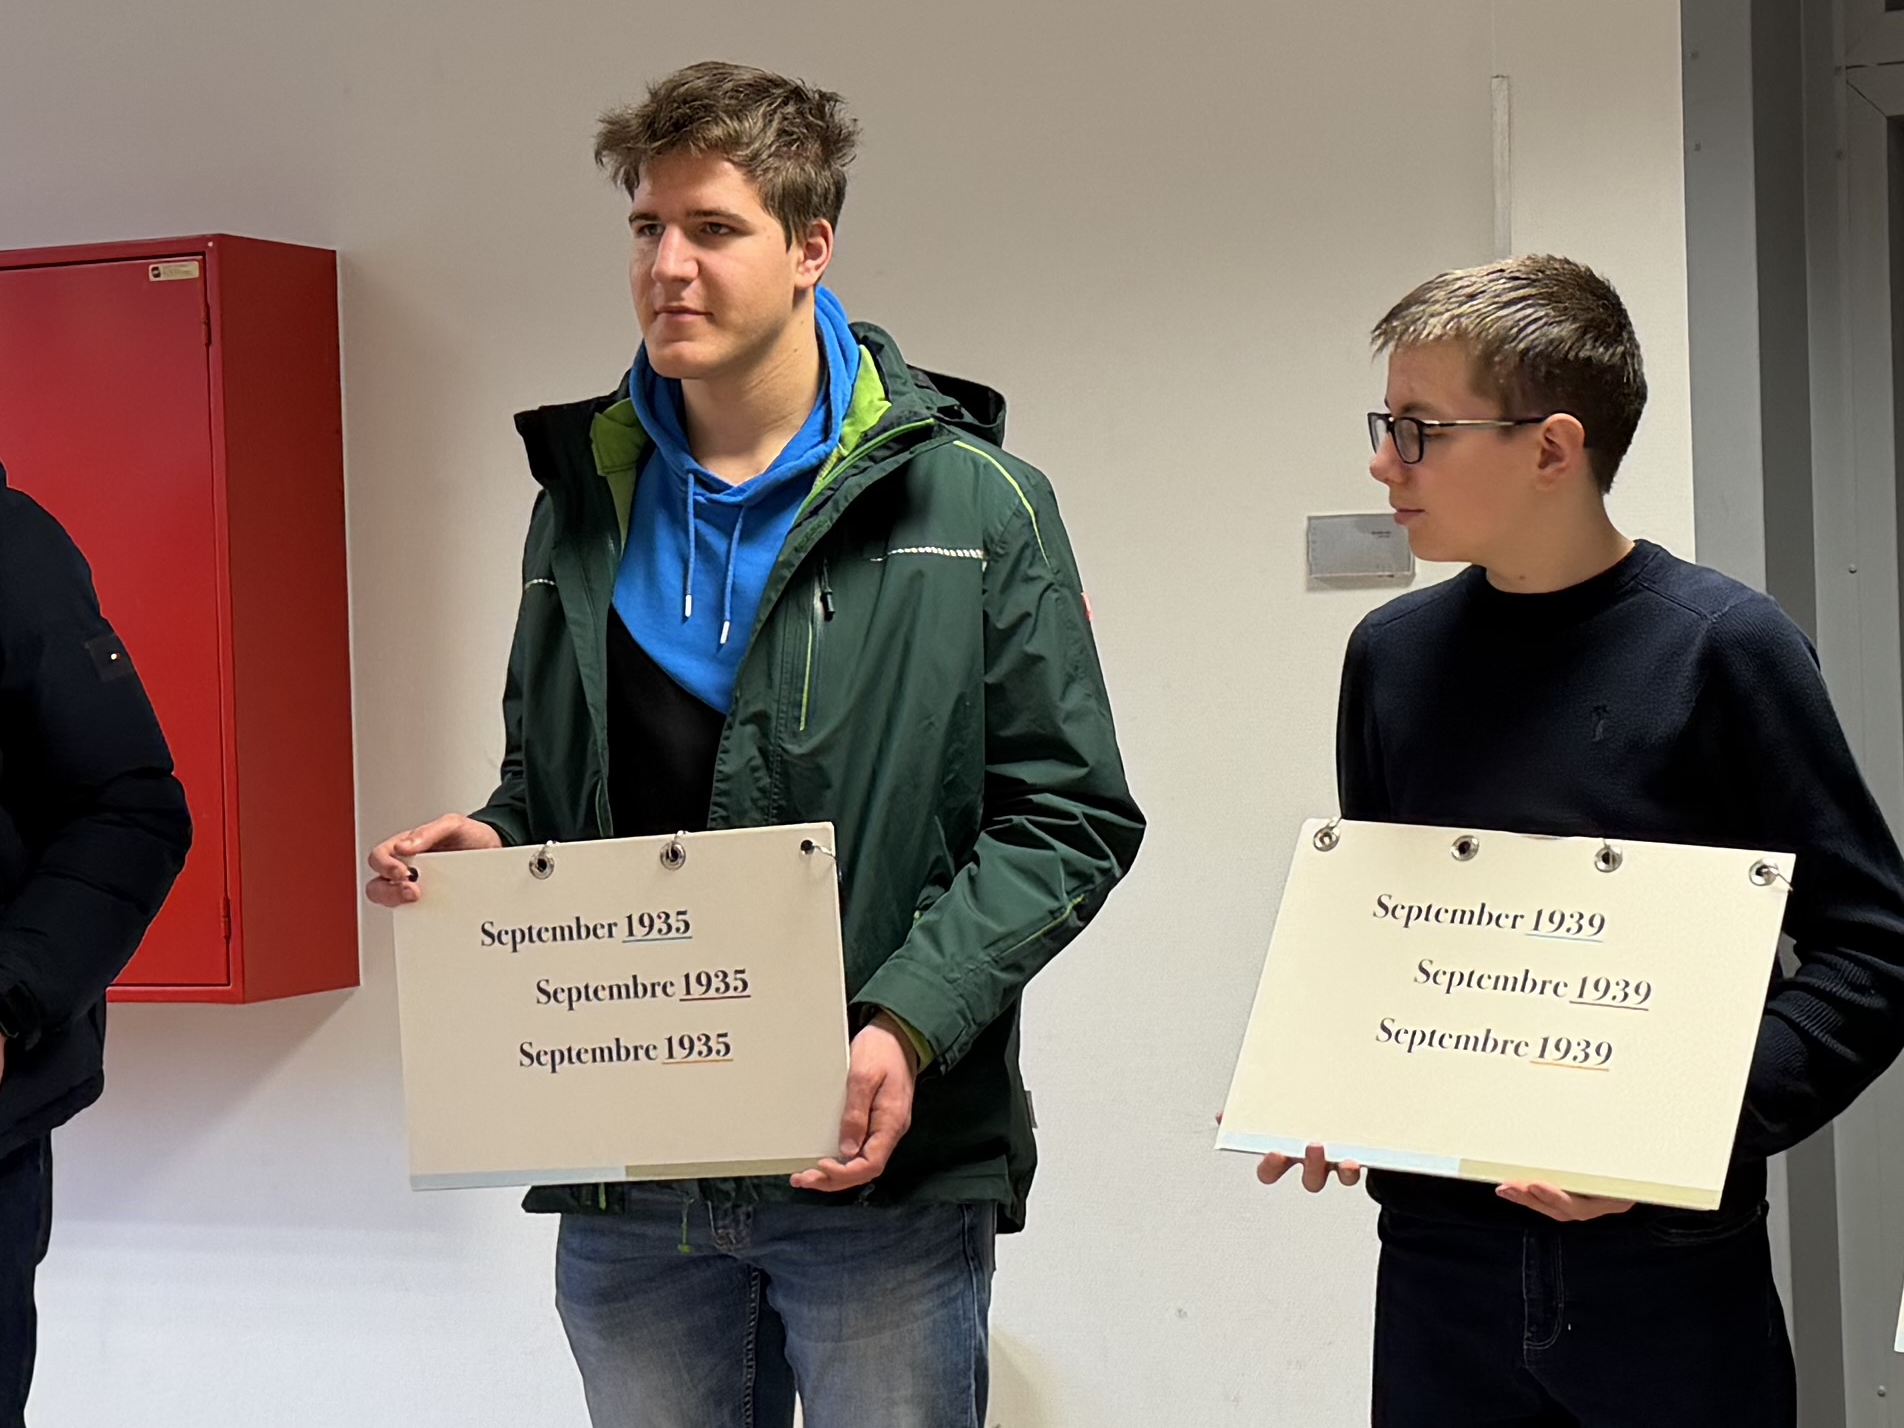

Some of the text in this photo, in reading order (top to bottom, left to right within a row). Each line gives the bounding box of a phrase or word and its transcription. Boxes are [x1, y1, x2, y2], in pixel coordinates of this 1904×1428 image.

[481, 911, 690, 952] September 1935
[1373, 895, 1606, 937] September 1939
[536, 970, 748, 1011] Septembre 1935
[1414, 959, 1651, 1005] Septembre 1939
[520, 1033, 730, 1073] Septembre 1935
[1376, 1018, 1613, 1066] Septembre 1939
